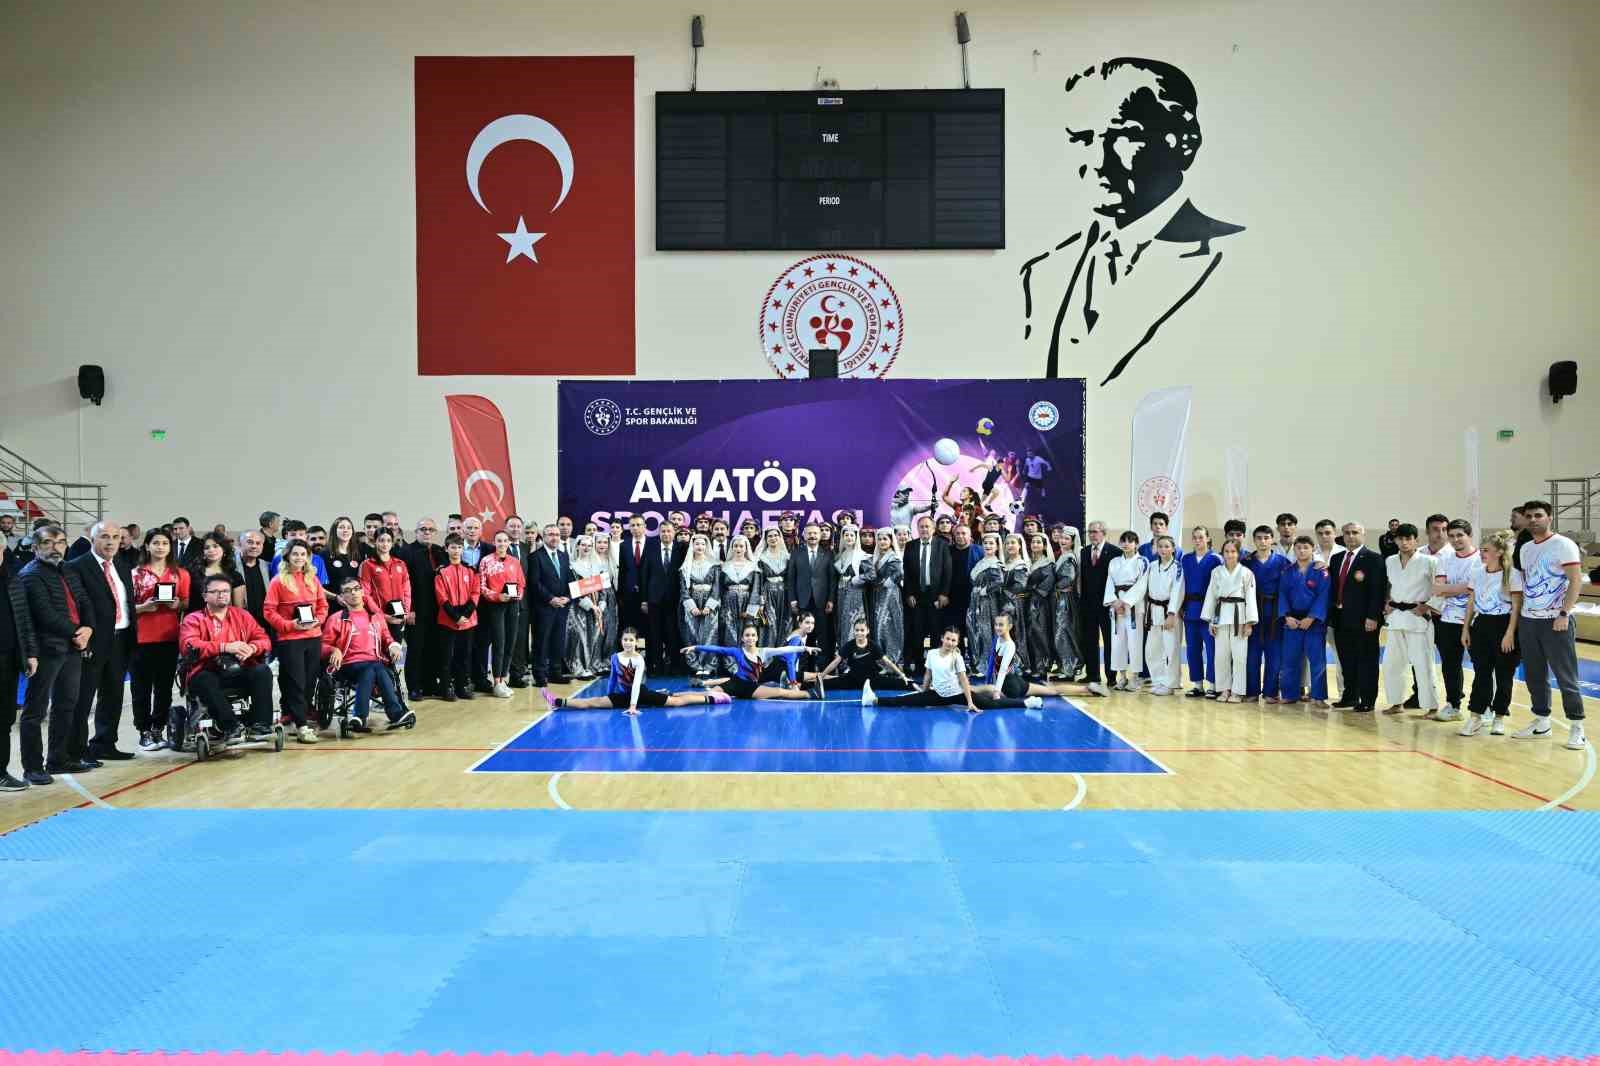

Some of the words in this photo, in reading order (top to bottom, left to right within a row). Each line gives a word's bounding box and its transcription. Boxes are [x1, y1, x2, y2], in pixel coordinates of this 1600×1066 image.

[822, 133, 839, 143] TIME
[819, 196, 840, 205] PERIOD
[818, 280, 857, 294] GENÇLİK
[857, 291, 868, 303] VE
[866, 303, 877, 327] SPOR
[844, 328, 877, 369] BAKANLIĞI
[643, 406, 684, 416] GENÇLİK
[625, 417, 648, 425] SPOR
[650, 416, 697, 425] BAKANLIĞI
[629, 460, 817, 503] AMATÖR
